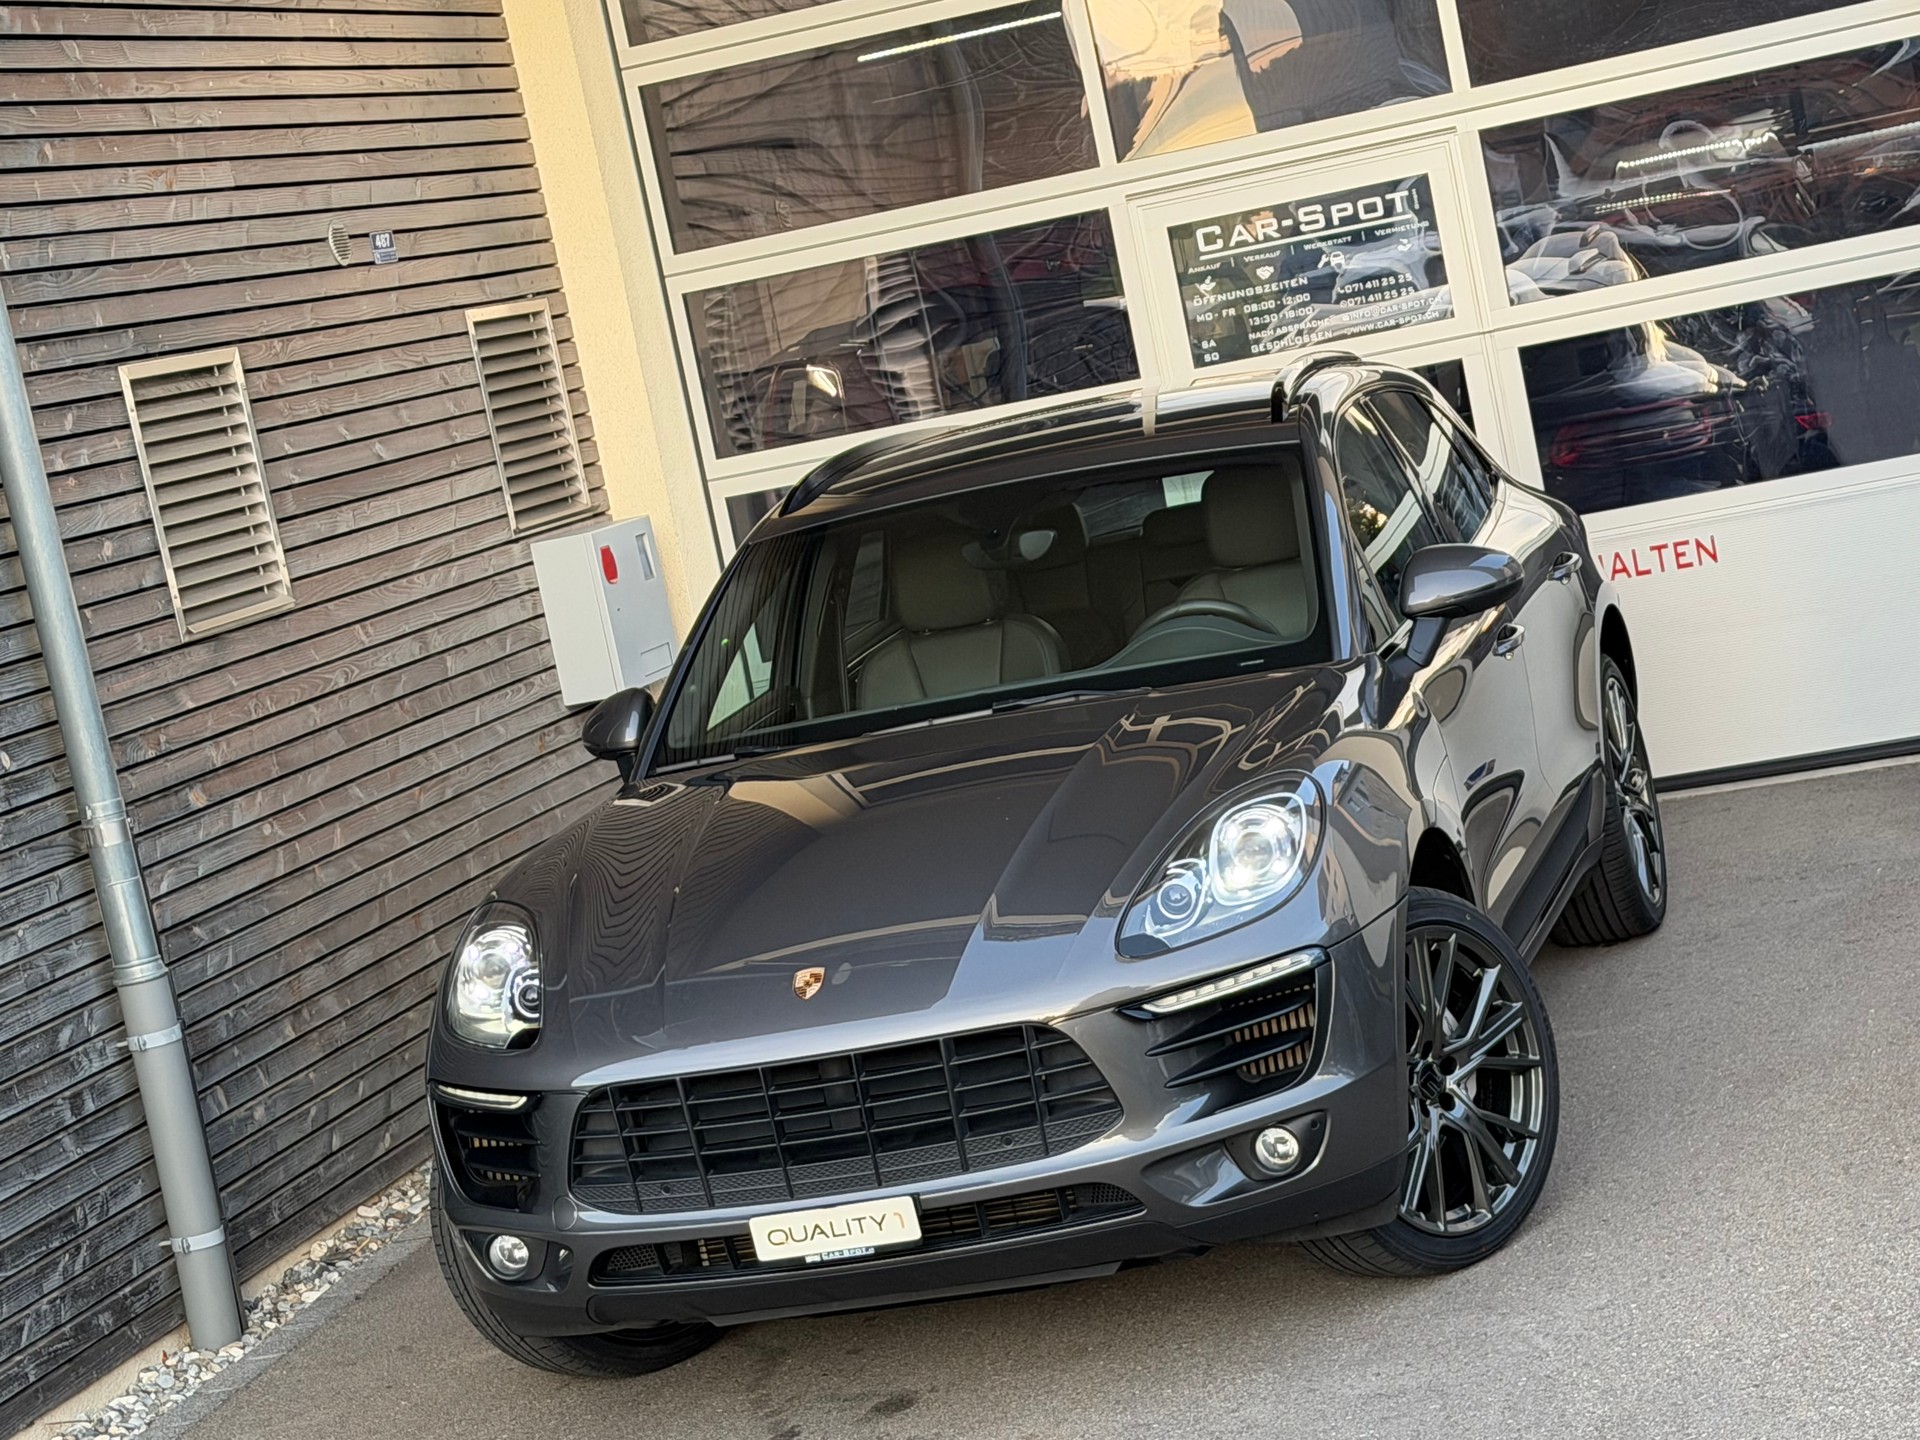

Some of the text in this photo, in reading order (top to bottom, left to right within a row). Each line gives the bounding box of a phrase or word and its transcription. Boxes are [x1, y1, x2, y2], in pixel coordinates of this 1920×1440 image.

[1196, 190, 1409, 253] CAR-SPOT
[1374, 220, 1430, 237] VERMIETUNG
[1303, 236, 1352, 251] WERKSTATT
[1243, 250, 1281, 263] VERKAUF
[1187, 262, 1222, 275] ANKAUF
[1193, 276, 1309, 306] ÖFFNUNGSZEITEN
[1344, 272, 1413, 294] 071 411 25 25
[1243, 300, 1276, 314] 08:00
[1282, 292, 1311, 305] 12:00
[1347, 286, 1415, 308] 071 411 25 25
[1222, 307, 1236, 318] FR
[1248, 312, 1279, 327] 13:30
[1248, 330, 1275, 341] NACH
[1250, 330, 1333, 353] GESCHLOSSEN
[1201, 340, 1217, 350] SA
[1204, 352, 1220, 363] SO
[767, 1213, 887, 1246] QUALITY
